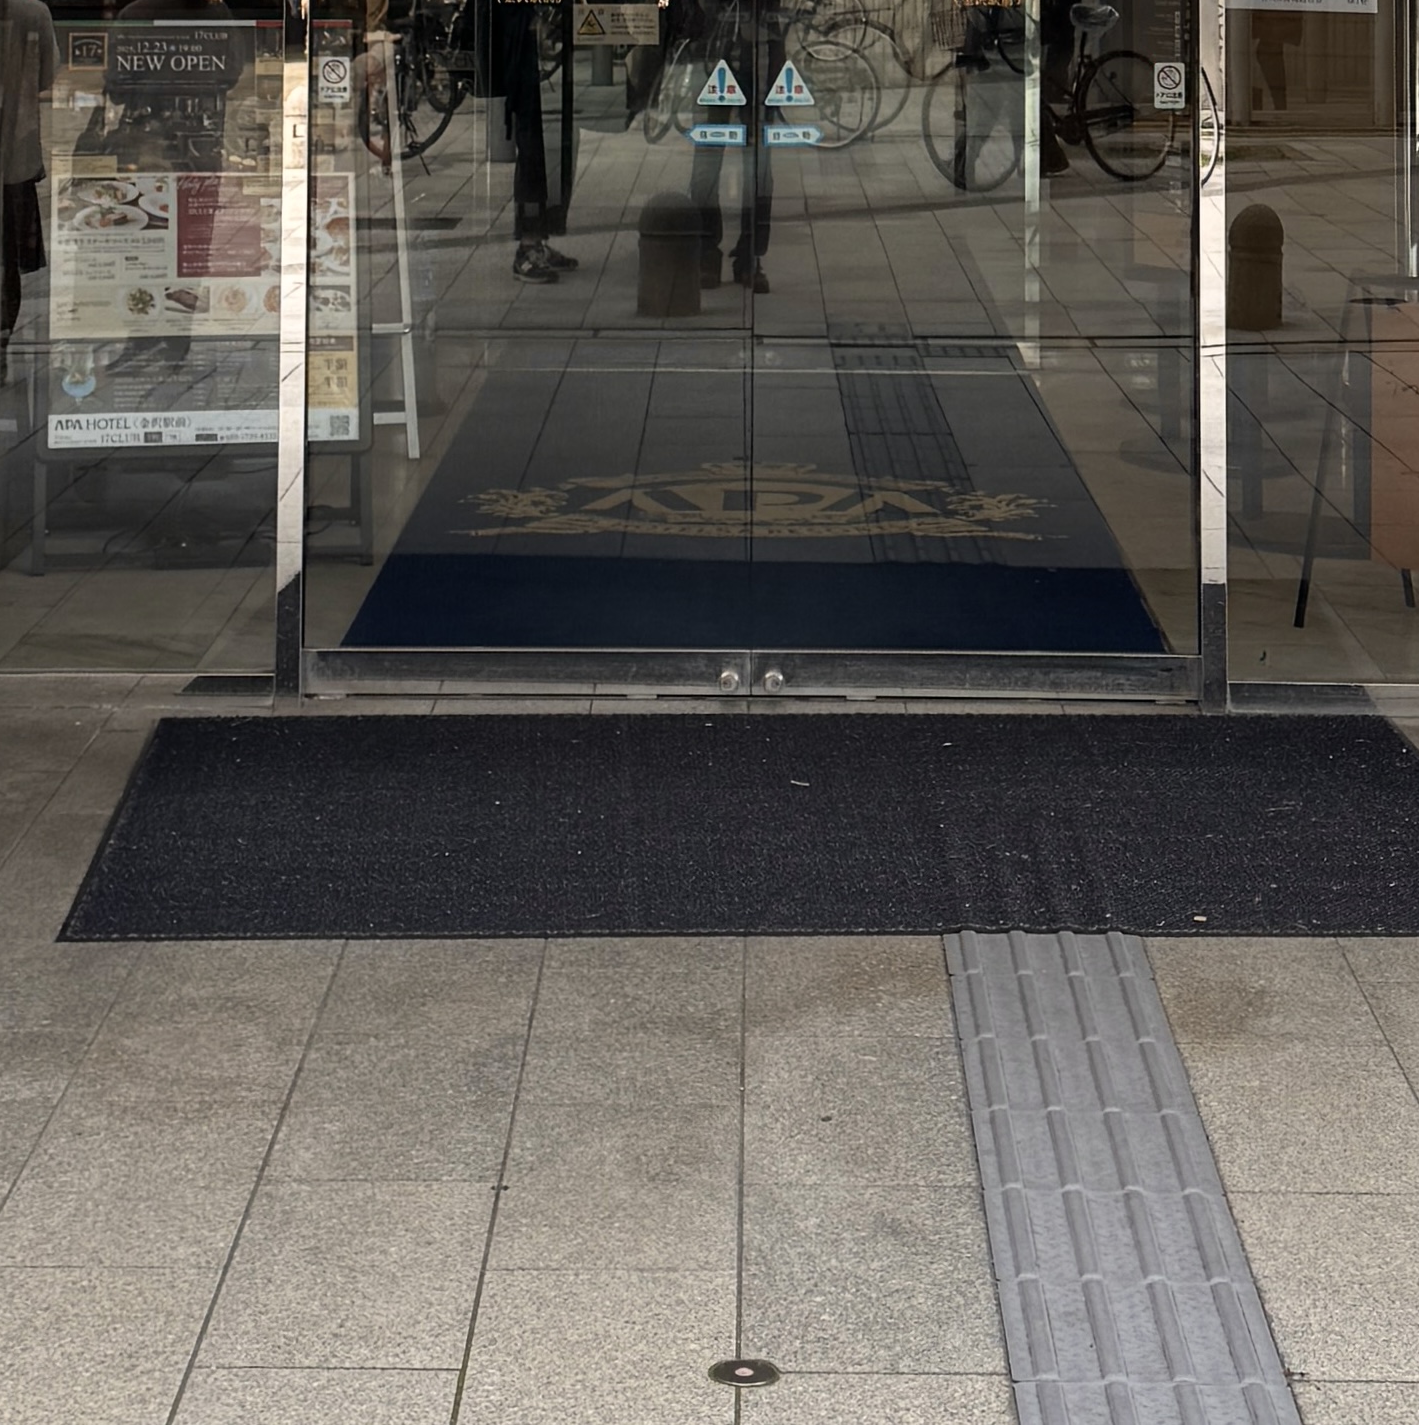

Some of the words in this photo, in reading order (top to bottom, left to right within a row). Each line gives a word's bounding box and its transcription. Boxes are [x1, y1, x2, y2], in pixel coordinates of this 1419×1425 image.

[116, 55, 165, 72] NEW
[170, 55, 226, 72] OPEN
[54, 419, 83, 431] APA
[86, 418, 130, 430] HOTEL
